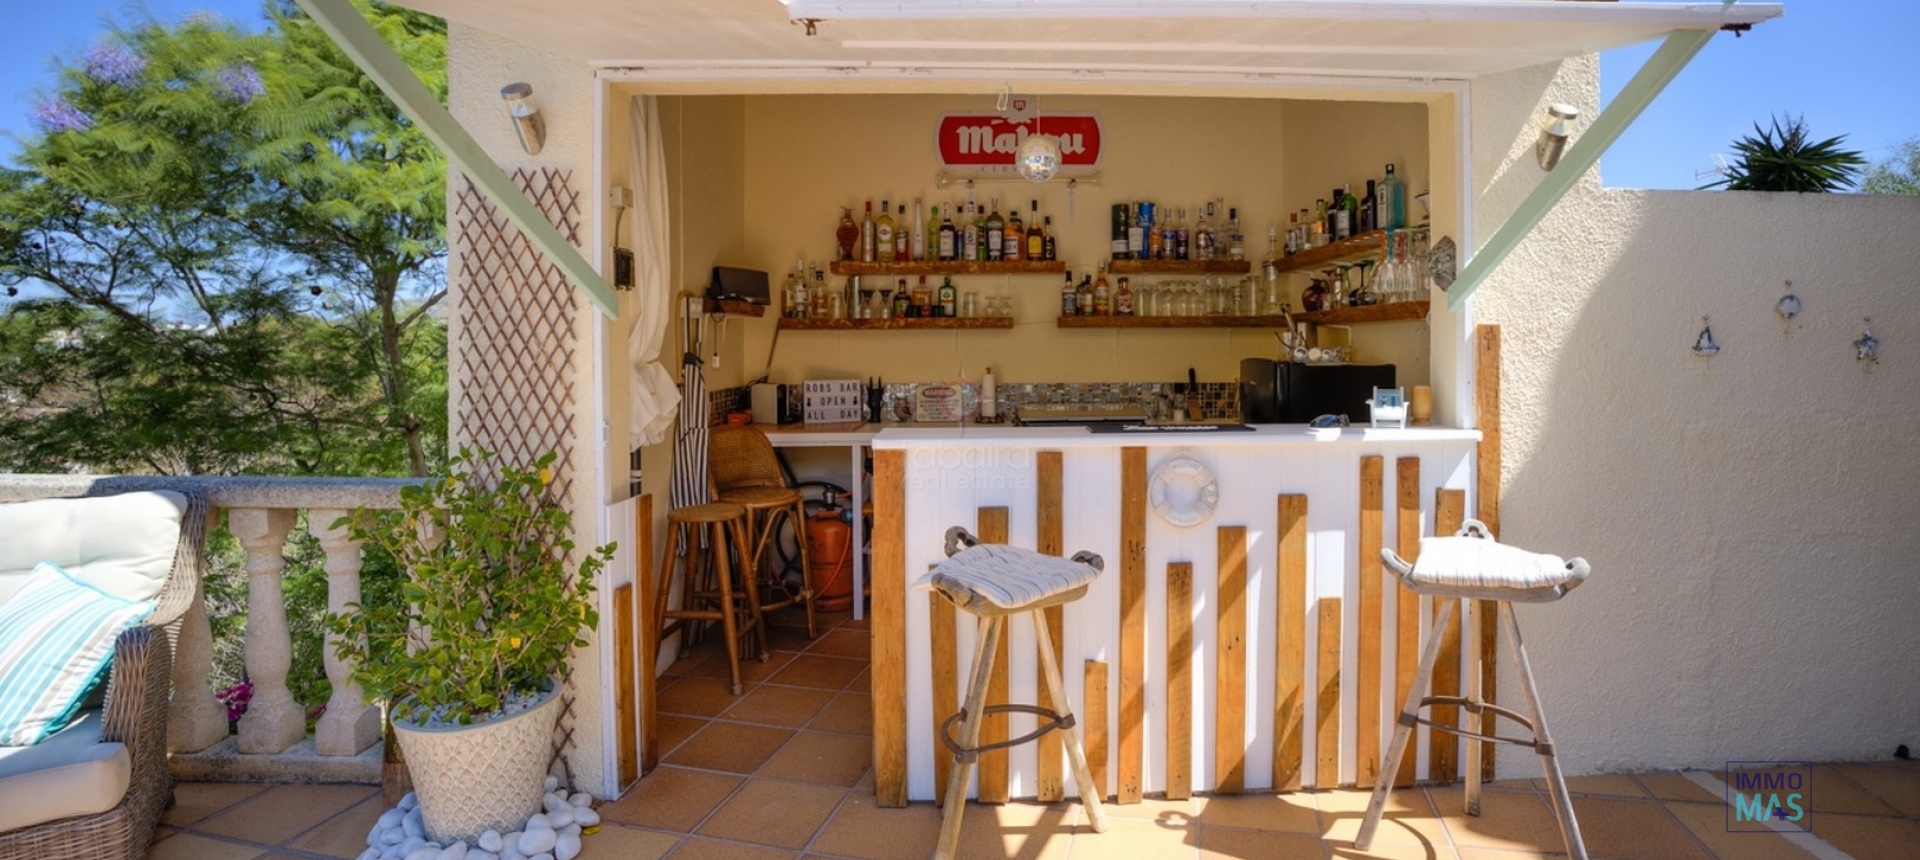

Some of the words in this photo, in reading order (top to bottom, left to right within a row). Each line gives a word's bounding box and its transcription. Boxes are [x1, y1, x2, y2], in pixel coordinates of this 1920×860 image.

[956, 125, 1085, 155] Mau
[805, 383, 832, 393] ROBS
[839, 382, 858, 392] BAR
[820, 396, 847, 406] OPEN
[807, 410, 825, 420] ALL
[840, 409, 858, 419] DAY
